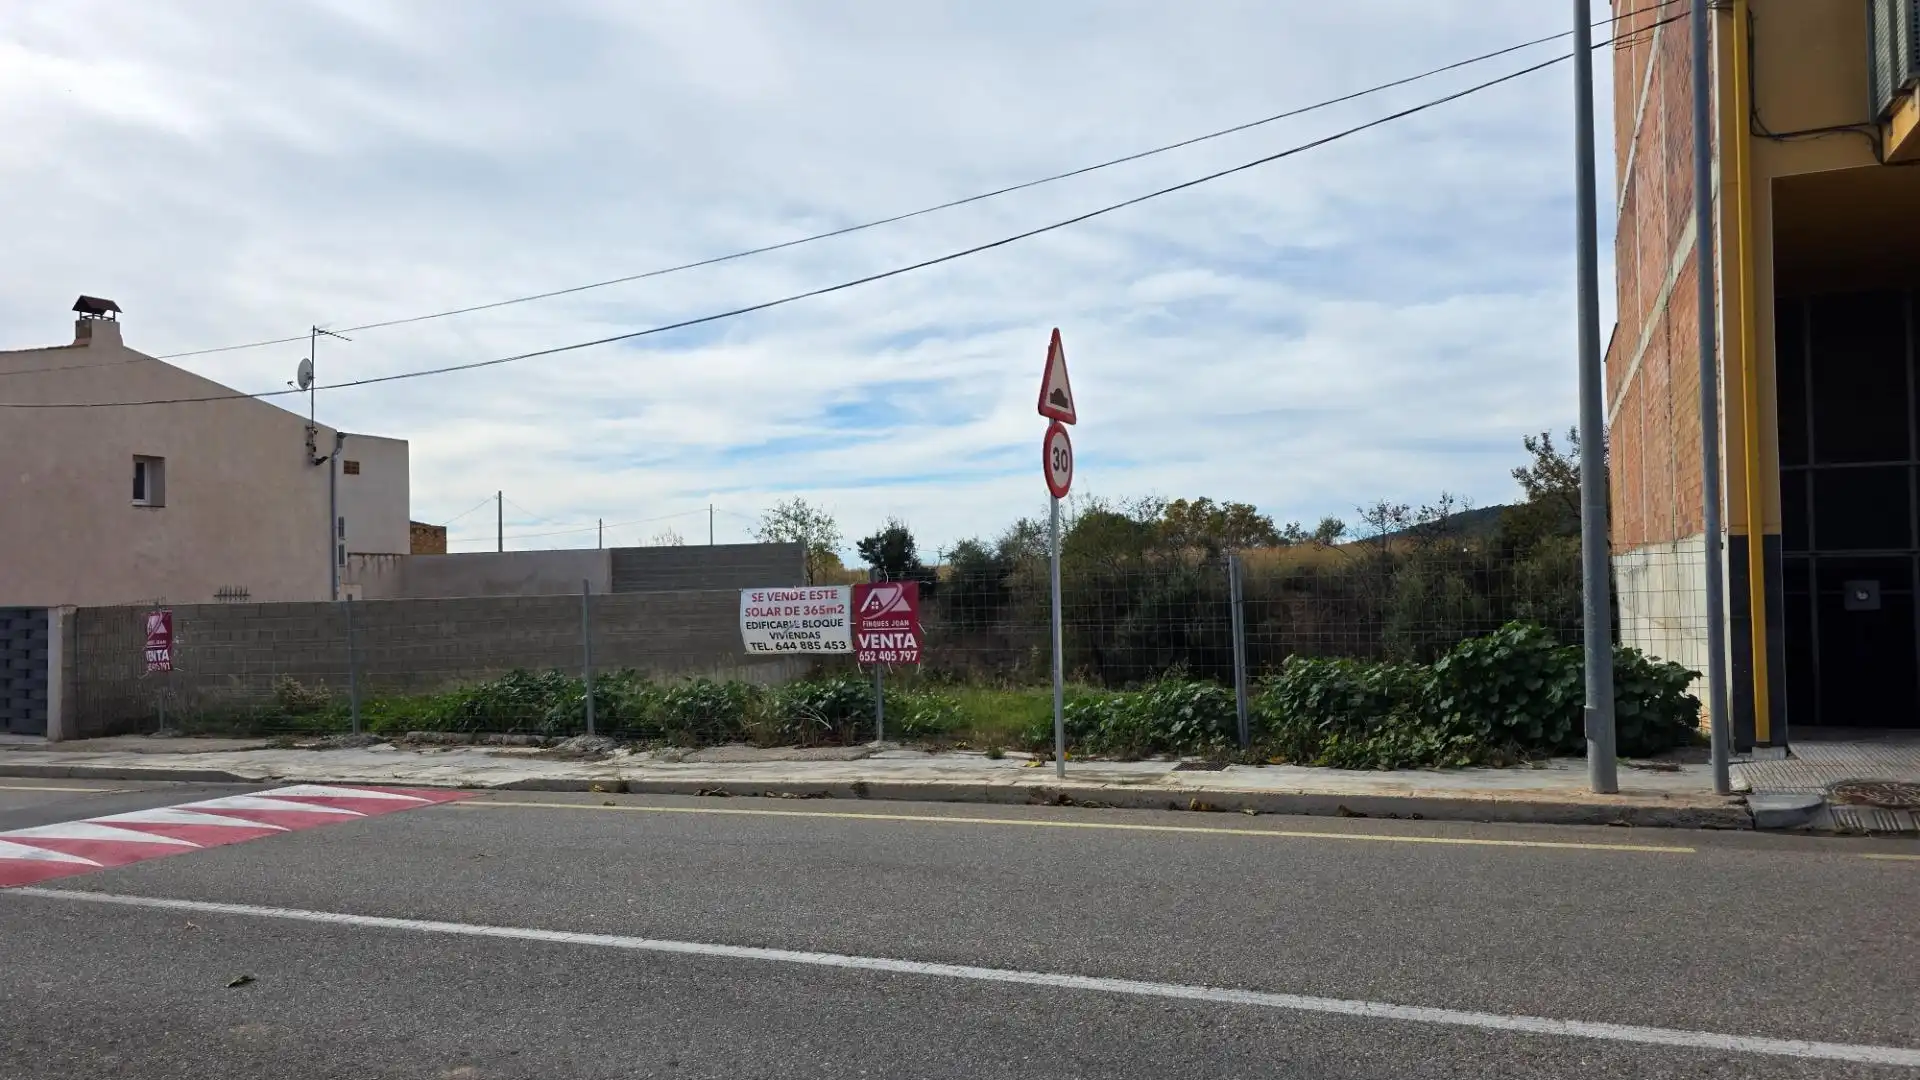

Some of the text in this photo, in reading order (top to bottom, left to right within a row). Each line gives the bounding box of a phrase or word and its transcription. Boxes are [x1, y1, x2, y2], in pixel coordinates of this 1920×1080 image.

[1053, 446, 1068, 472] 30
[751, 590, 838, 602] SE VENDE ESTE
[745, 604, 845, 617] SOLAR DE 365m2
[802, 618, 844, 628] BLOQUE
[862, 619, 910, 628] FINQUES JOAN
[769, 631, 821, 640] VIVIENDAS
[858, 633, 917, 649] VENTA
[750, 640, 847, 651] TEL. 644 885 453
[859, 650, 918, 661] 652 405 797
